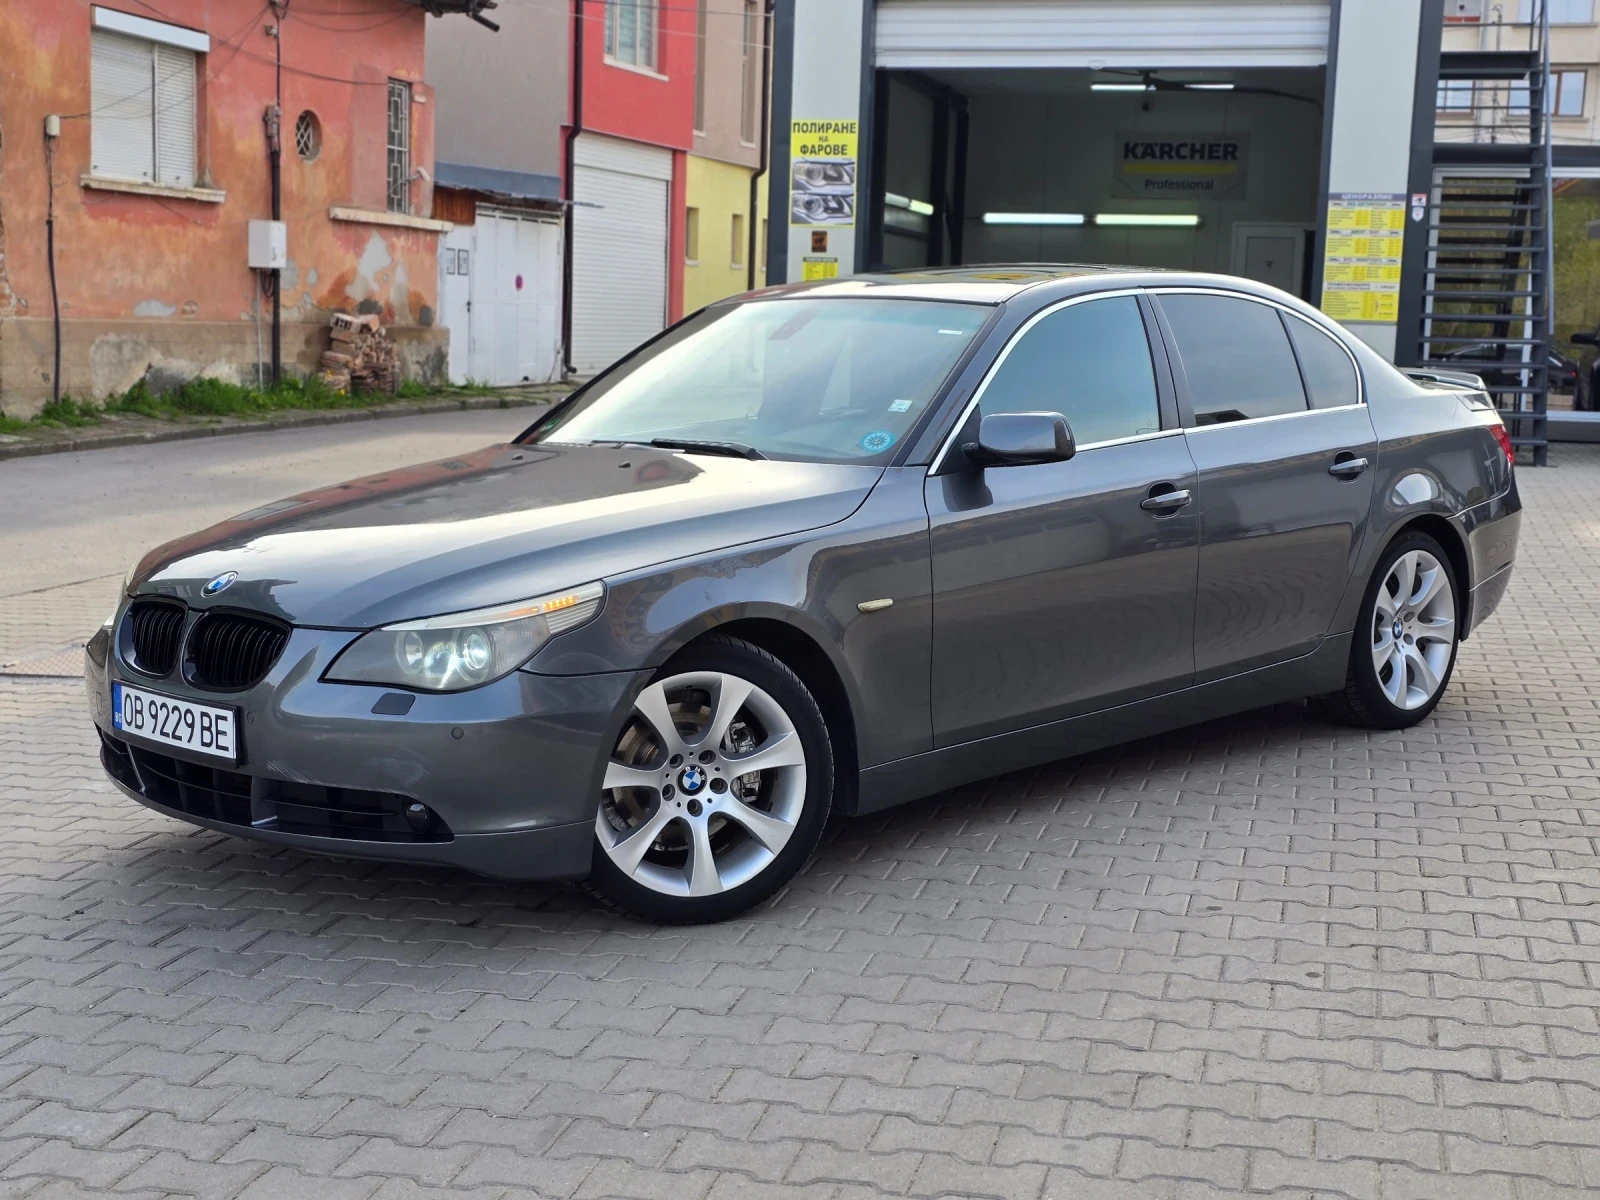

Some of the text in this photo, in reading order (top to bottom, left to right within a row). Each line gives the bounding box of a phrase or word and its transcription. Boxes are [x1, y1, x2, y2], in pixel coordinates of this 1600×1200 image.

[792, 122, 857, 134] ПОЛИРАНЕ
[818, 135, 829, 143] НА
[800, 144, 848, 156] ФАРОВЕ
[1123, 142, 1238, 160] KÄRCHER
[1145, 179, 1214, 190] Professional
[148, 699, 195, 743] 9229
[200, 710, 230, 752] BE
